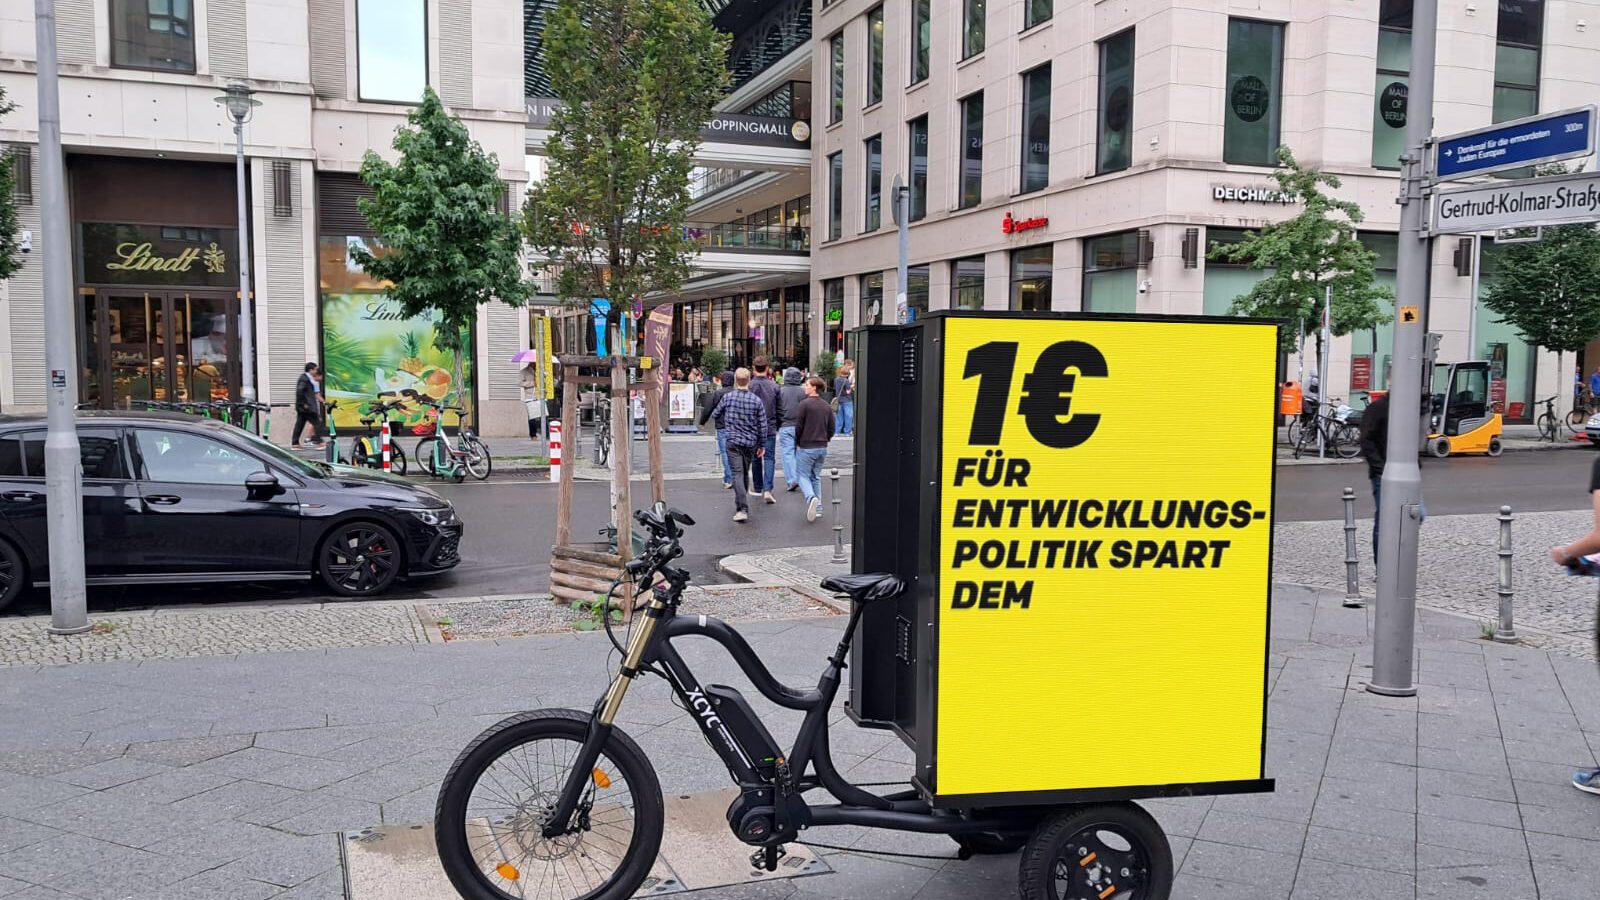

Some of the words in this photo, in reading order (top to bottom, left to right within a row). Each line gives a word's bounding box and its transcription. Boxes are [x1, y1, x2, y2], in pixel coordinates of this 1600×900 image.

[1241, 81, 1262, 90] MALL
[1243, 92, 1256, 102] OF
[1237, 104, 1262, 115] BERLIN
[1392, 100, 1403, 109] OF
[1457, 140, 1486, 155] Denkmal
[1487, 139, 1497, 149] für
[1497, 137, 1509, 147] die
[1510, 129, 1550, 144] ermordeten
[1457, 153, 1478, 163] Juden
[1478, 148, 1506, 160] Europas
[106, 242, 201, 272] Lindt
[962, 340, 1109, 449] 1€
[953, 449, 1031, 487] FÜR
[952, 499, 1266, 529] ENTWICKLUNGS-
[951, 539, 1103, 569] POLITIK
[1108, 539, 1230, 569] SPART
[950, 580, 1034, 610] DEM
[685, 686, 721, 729] XCYC
